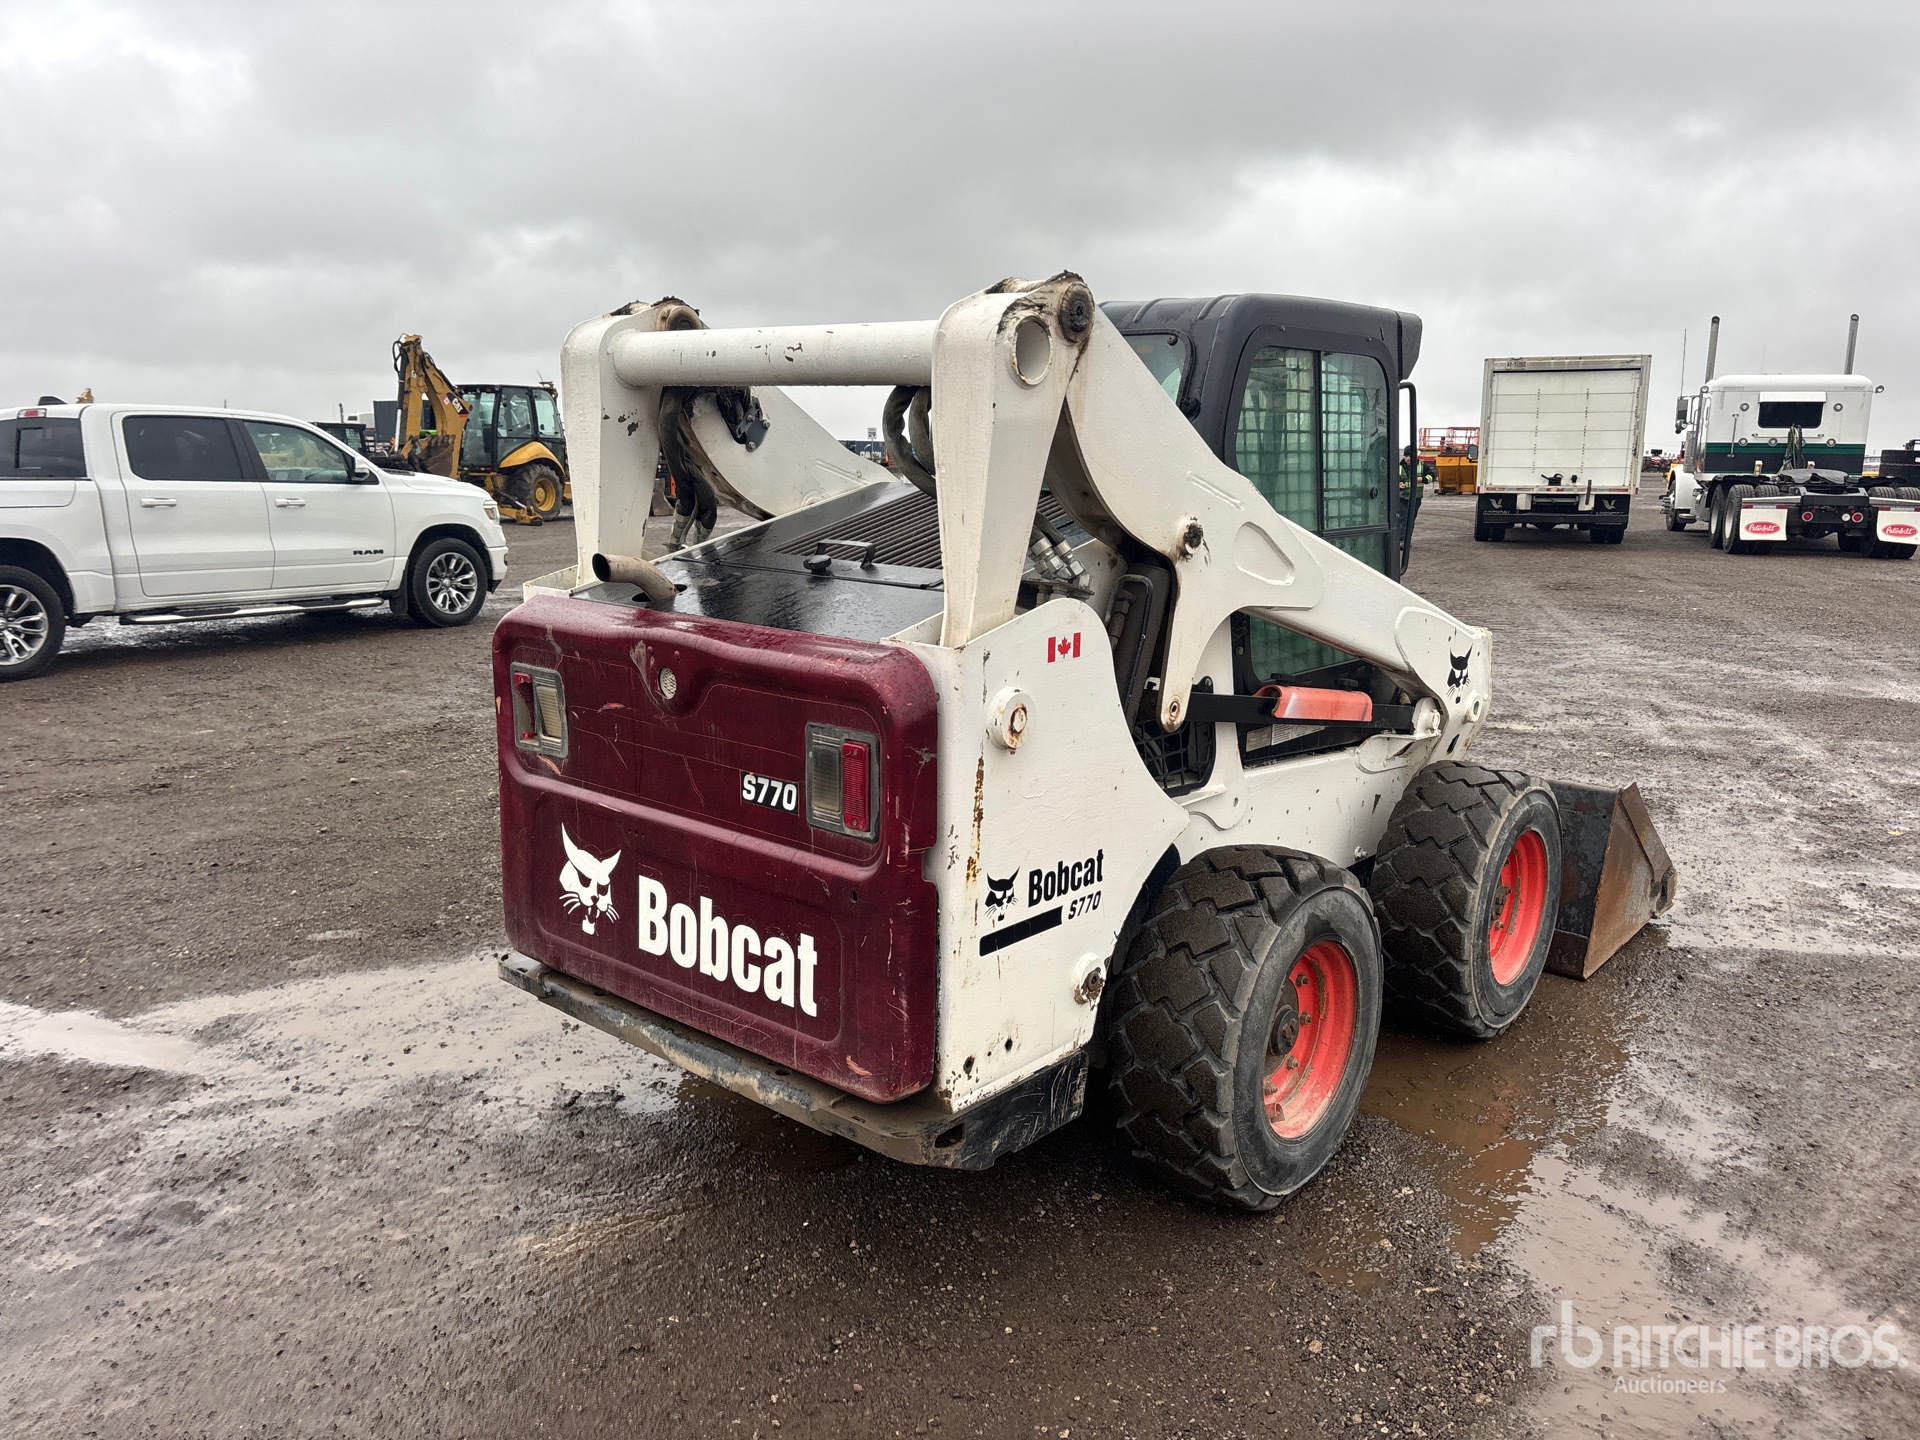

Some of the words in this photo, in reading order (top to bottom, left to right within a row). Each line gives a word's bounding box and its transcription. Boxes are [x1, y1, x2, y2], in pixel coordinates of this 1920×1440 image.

[452, 398, 464, 413] CAT
[1748, 524, 1778, 532] Peterbilt
[1886, 526, 1915, 535] Peterbilt
[742, 774, 798, 812] S770
[1028, 848, 1104, 908] Bobcat
[1068, 890, 1102, 920] S770
[638, 875, 818, 1017] Bobcat
